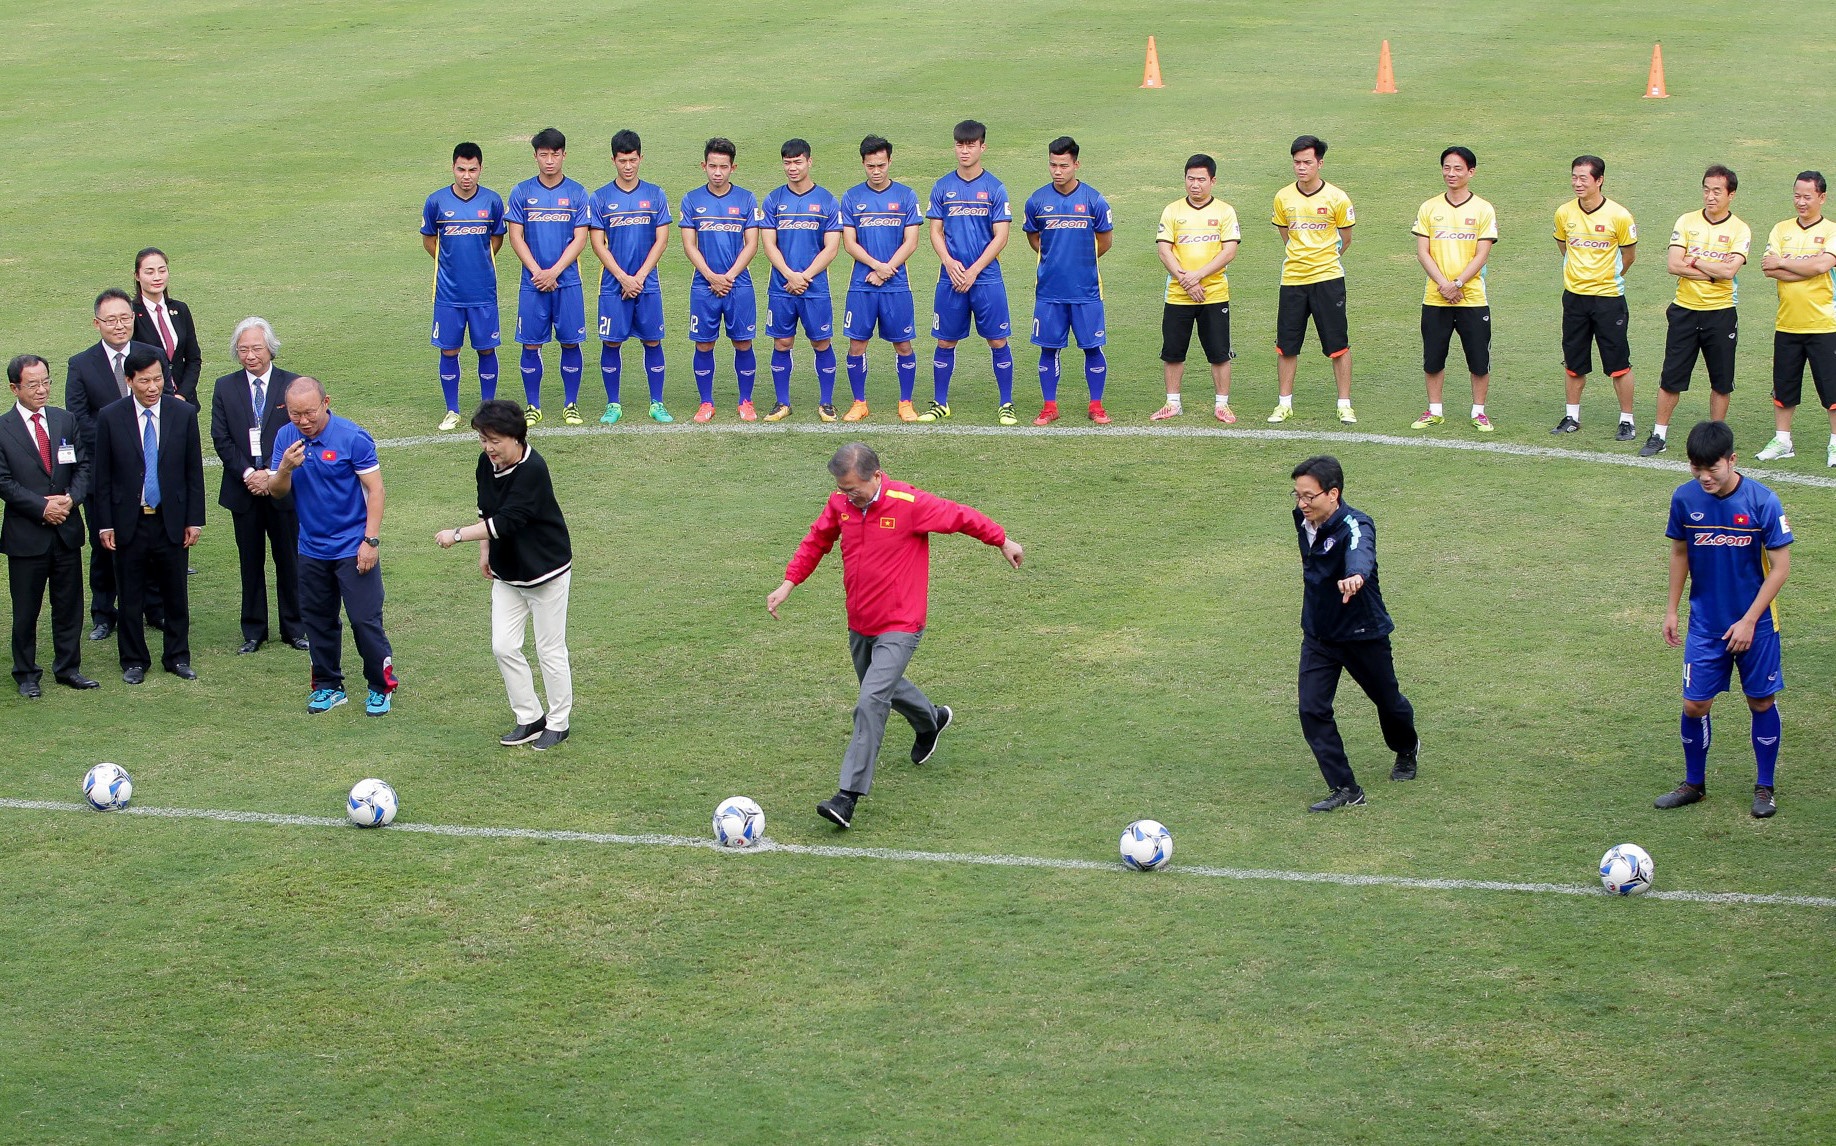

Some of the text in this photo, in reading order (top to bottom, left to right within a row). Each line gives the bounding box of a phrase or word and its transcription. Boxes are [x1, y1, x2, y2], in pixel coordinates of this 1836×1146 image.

[527, 212, 571, 222] Z.com
[948, 206, 989, 217] Z.com
[609, 216, 650, 227] Z.com
[698, 221, 742, 232] Z.com
[778, 219, 820, 230] Z.com
[859, 216, 902, 227] Z.com
[1044, 219, 1088, 230] Z.com
[1288, 221, 1328, 231] Z.com
[444, 225, 487, 236] Z.com
[1434, 230, 1476, 240] Z.com
[1178, 233, 1221, 244] Z.com
[1568, 237, 1610, 248] Z.com
[599, 316, 612, 336] 21
[1694, 532, 1752, 547] Z.com
